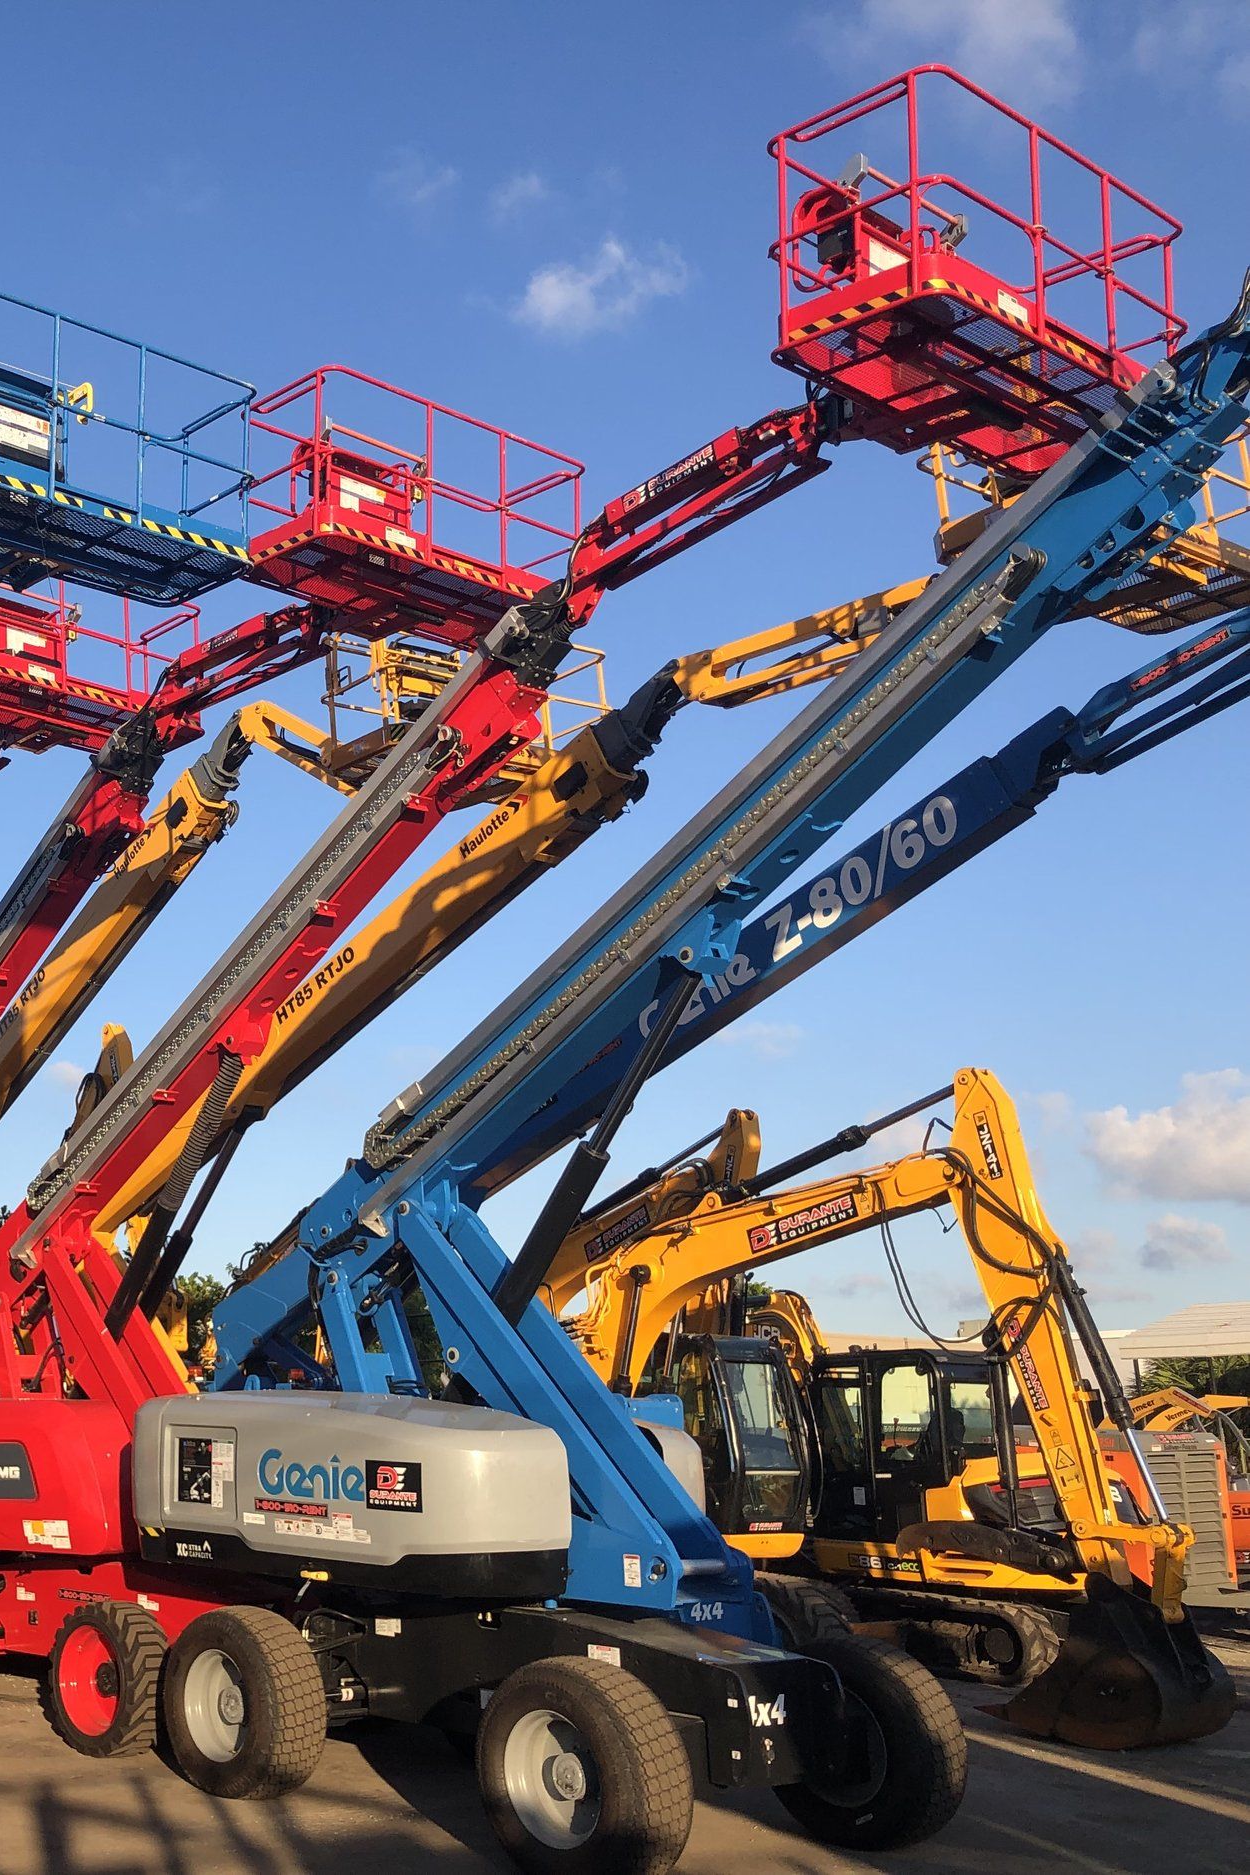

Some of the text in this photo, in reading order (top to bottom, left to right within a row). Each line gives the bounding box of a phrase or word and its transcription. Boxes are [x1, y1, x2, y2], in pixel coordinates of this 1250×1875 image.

[647, 445, 713, 491] DURANTE
[649, 455, 715, 497] EQUIPMENT
[459, 809, 510, 859] Haulotte
[114, 837, 145, 880] Haulotte
[765, 796, 958, 961] Z-80/60
[20, 968, 45, 1007] RTJO
[276, 947, 355, 1025] HT85 RTJO
[978, 1124, 999, 1172] JZ141
[602, 1208, 647, 1244] DURANTE
[604, 1217, 648, 1249] EQUIPMENT
[778, 1196, 852, 1233] DURANTE
[781, 1209, 854, 1240] EQUIPMENT
[1016, 1354, 1040, 1409] QUIPMENT
[1020, 1345, 1048, 1408] DURANTE
[1132, 1399, 1155, 1413] rmeer
[258, 1448, 365, 1502] Genie
[255, 1500, 327, 1516] 1-800-510-RENT
[369, 1490, 417, 1501] DURANTE
[176, 1543, 188, 1557] XC
[691, 1602, 724, 1622] 4x4
